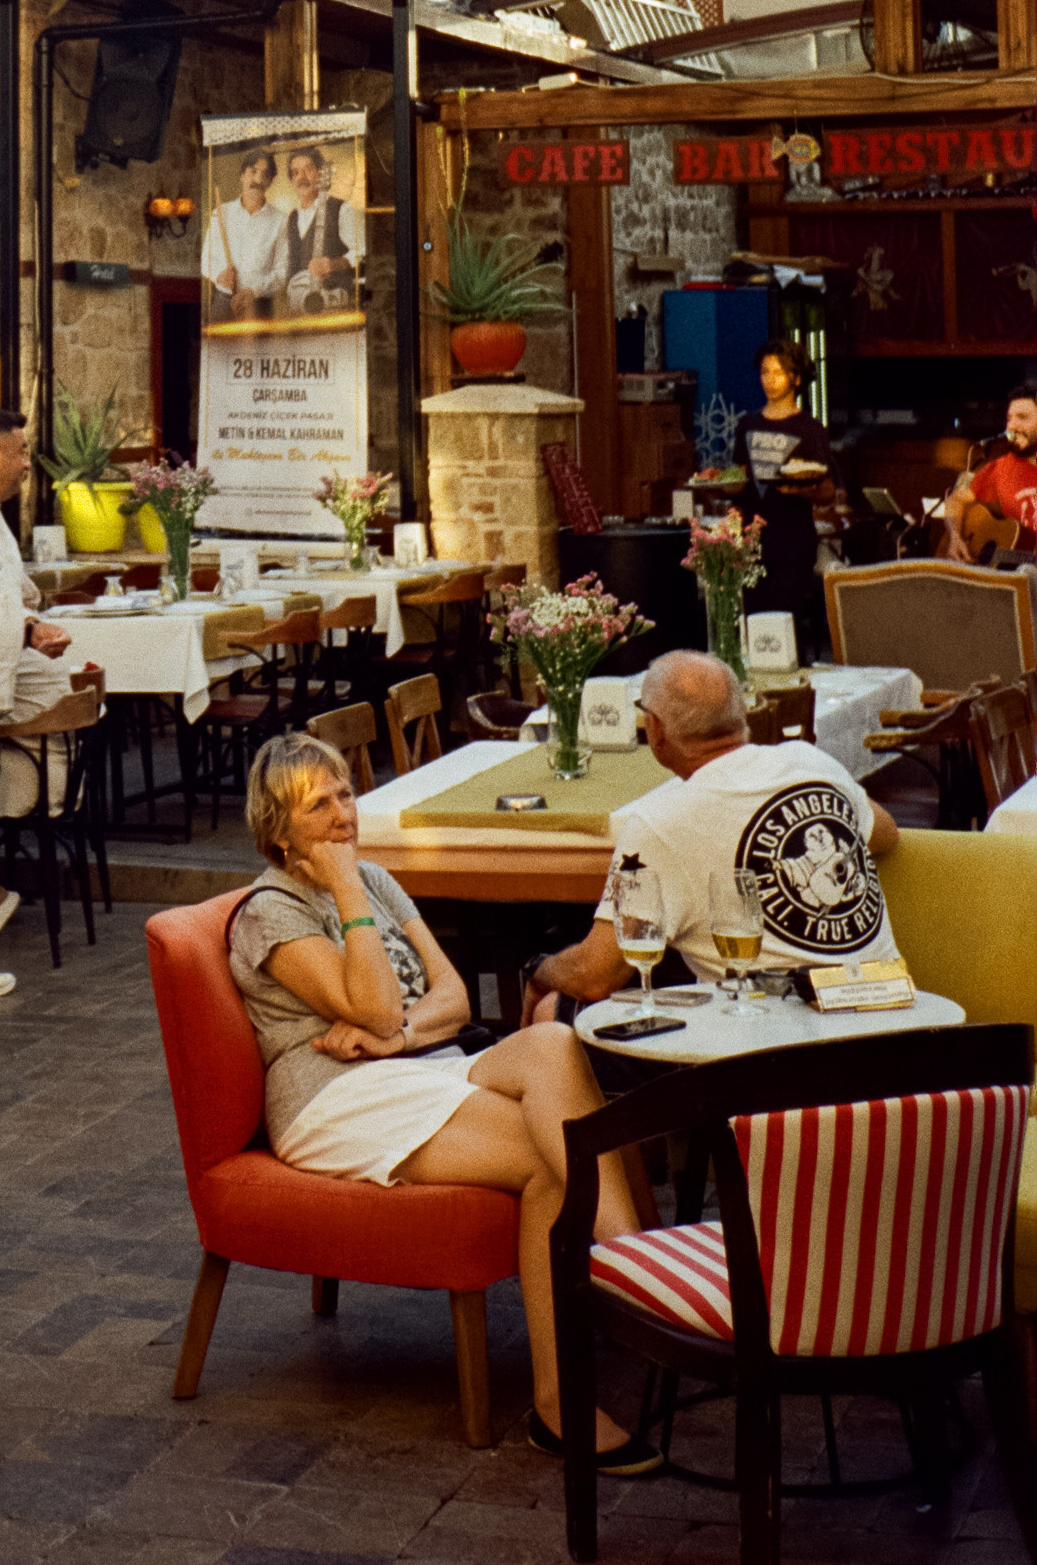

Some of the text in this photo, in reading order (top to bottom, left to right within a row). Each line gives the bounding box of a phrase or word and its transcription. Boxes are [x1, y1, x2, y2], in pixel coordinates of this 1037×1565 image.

[505, 128, 1036, 183] CAFE BAR RESTAU
[232, 354, 330, 380] 28 HAZİRAN
[252, 388, 308, 404] ÇARŞAMBA
[256, 426, 287, 441] KEMAL
[752, 819, 786, 860] LOS
[803, 915, 852, 942] TRUE
